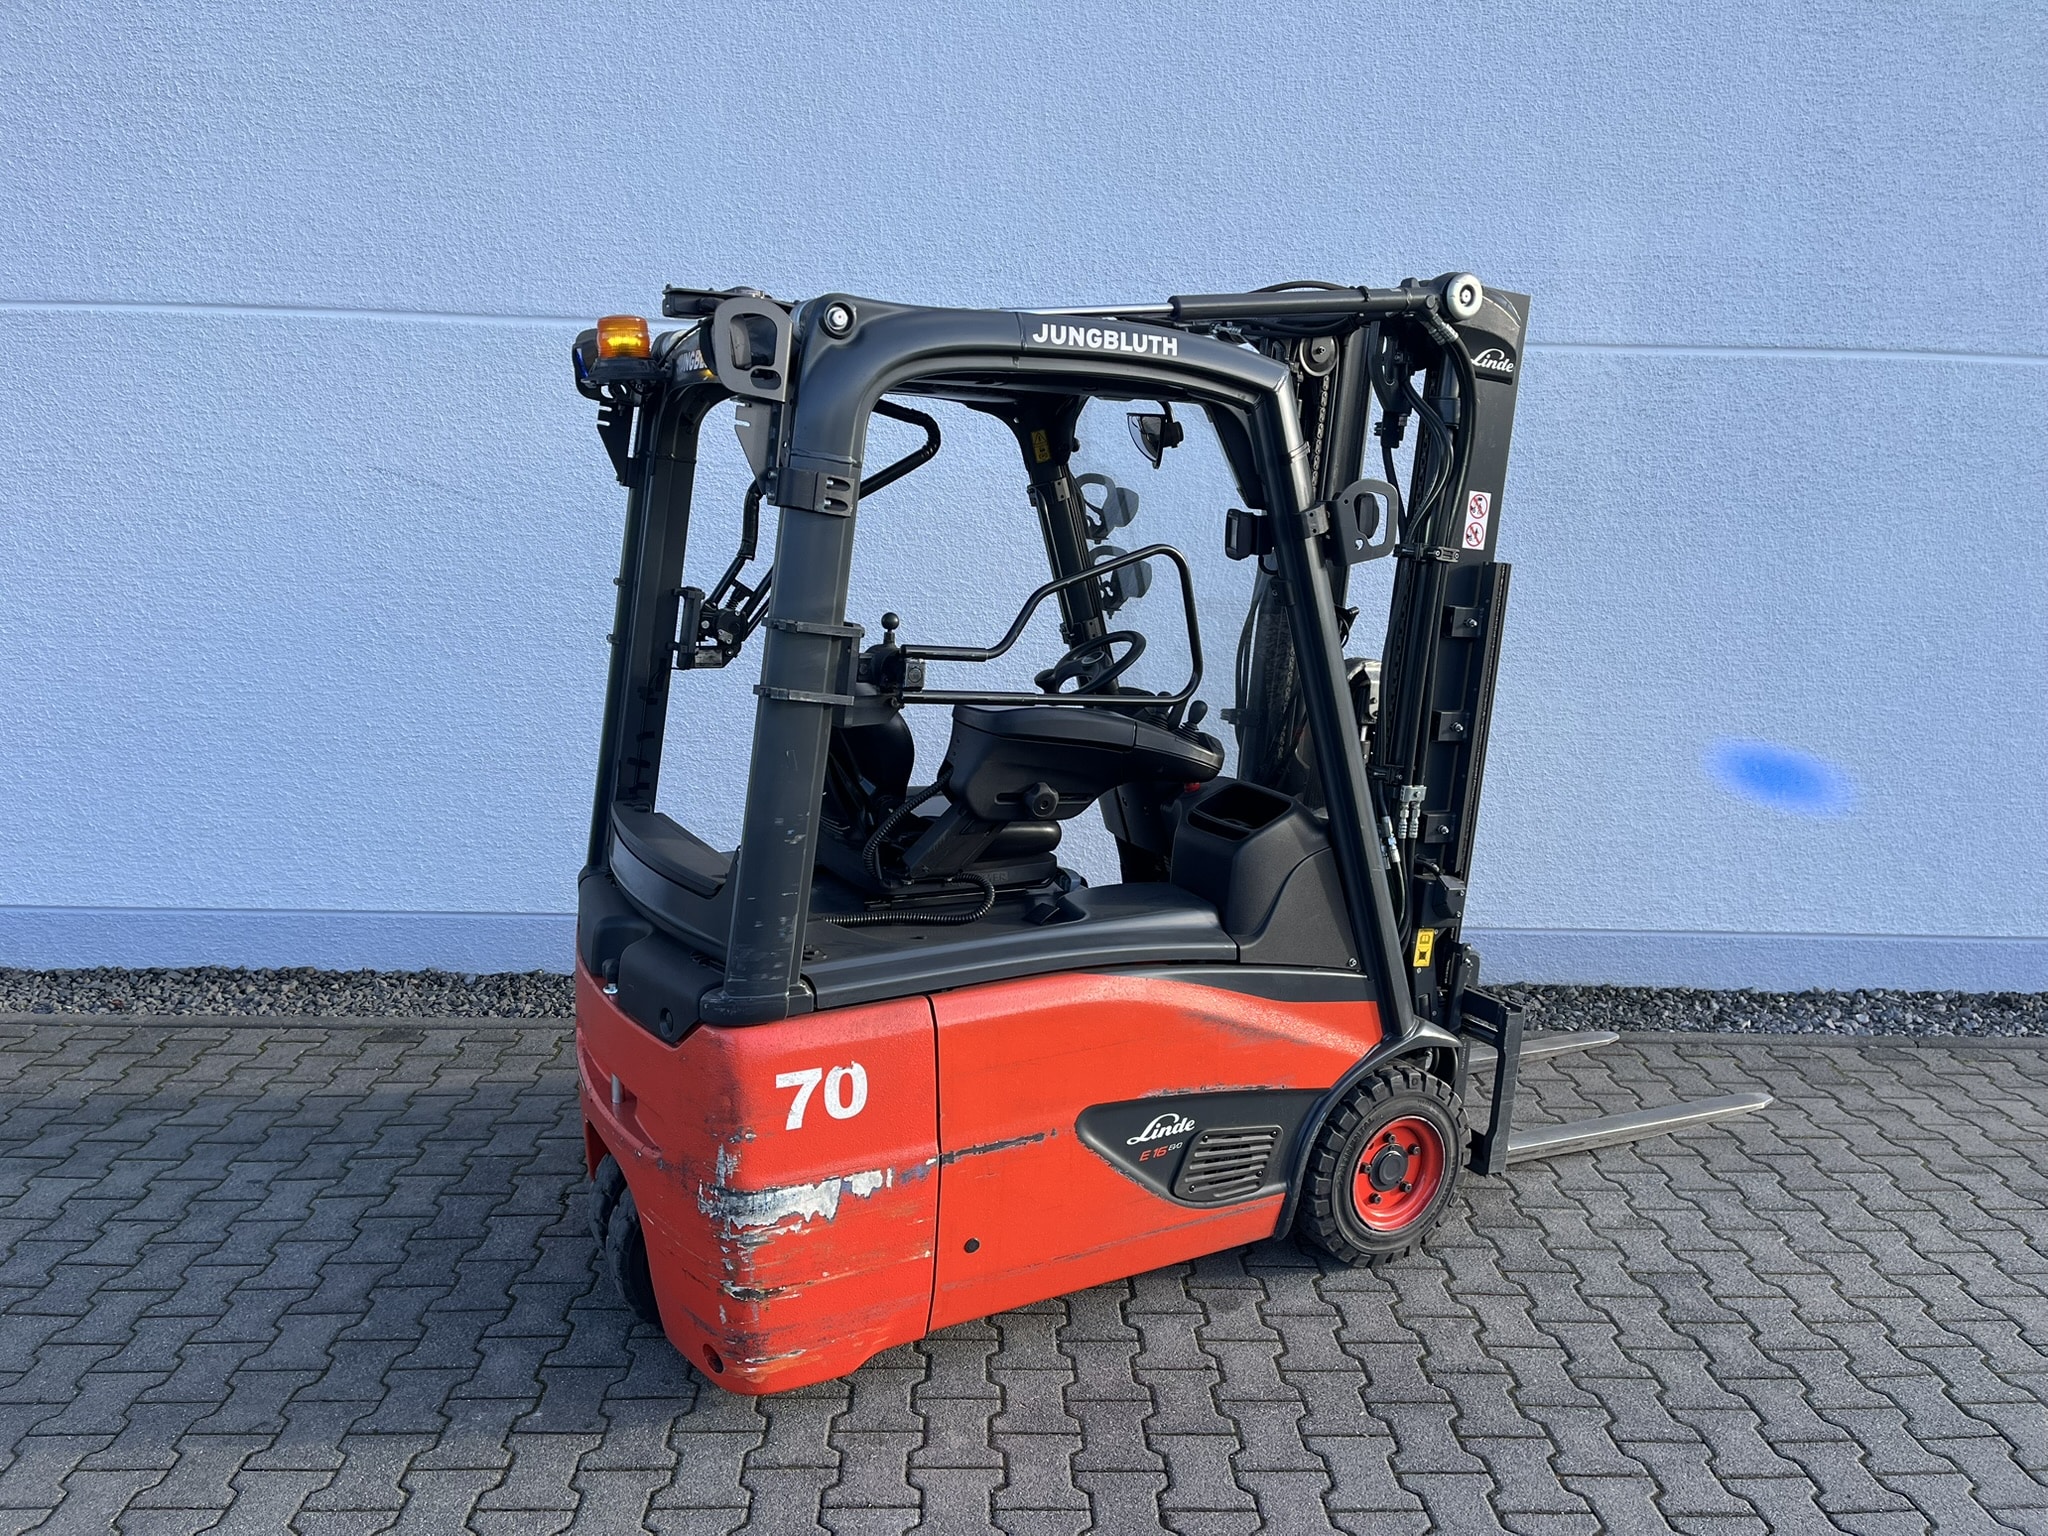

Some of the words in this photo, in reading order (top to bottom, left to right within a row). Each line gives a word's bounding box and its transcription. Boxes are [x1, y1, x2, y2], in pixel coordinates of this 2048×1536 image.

[1032, 323, 1178, 356] JUNGBLUTH
[1470, 348, 1514, 373] Linde
[775, 1061, 868, 1131] 70
[1126, 1113, 1196, 1145] Linde
[1139, 1149, 1152, 1162] E
[1153, 1145, 1169, 1158] 16
